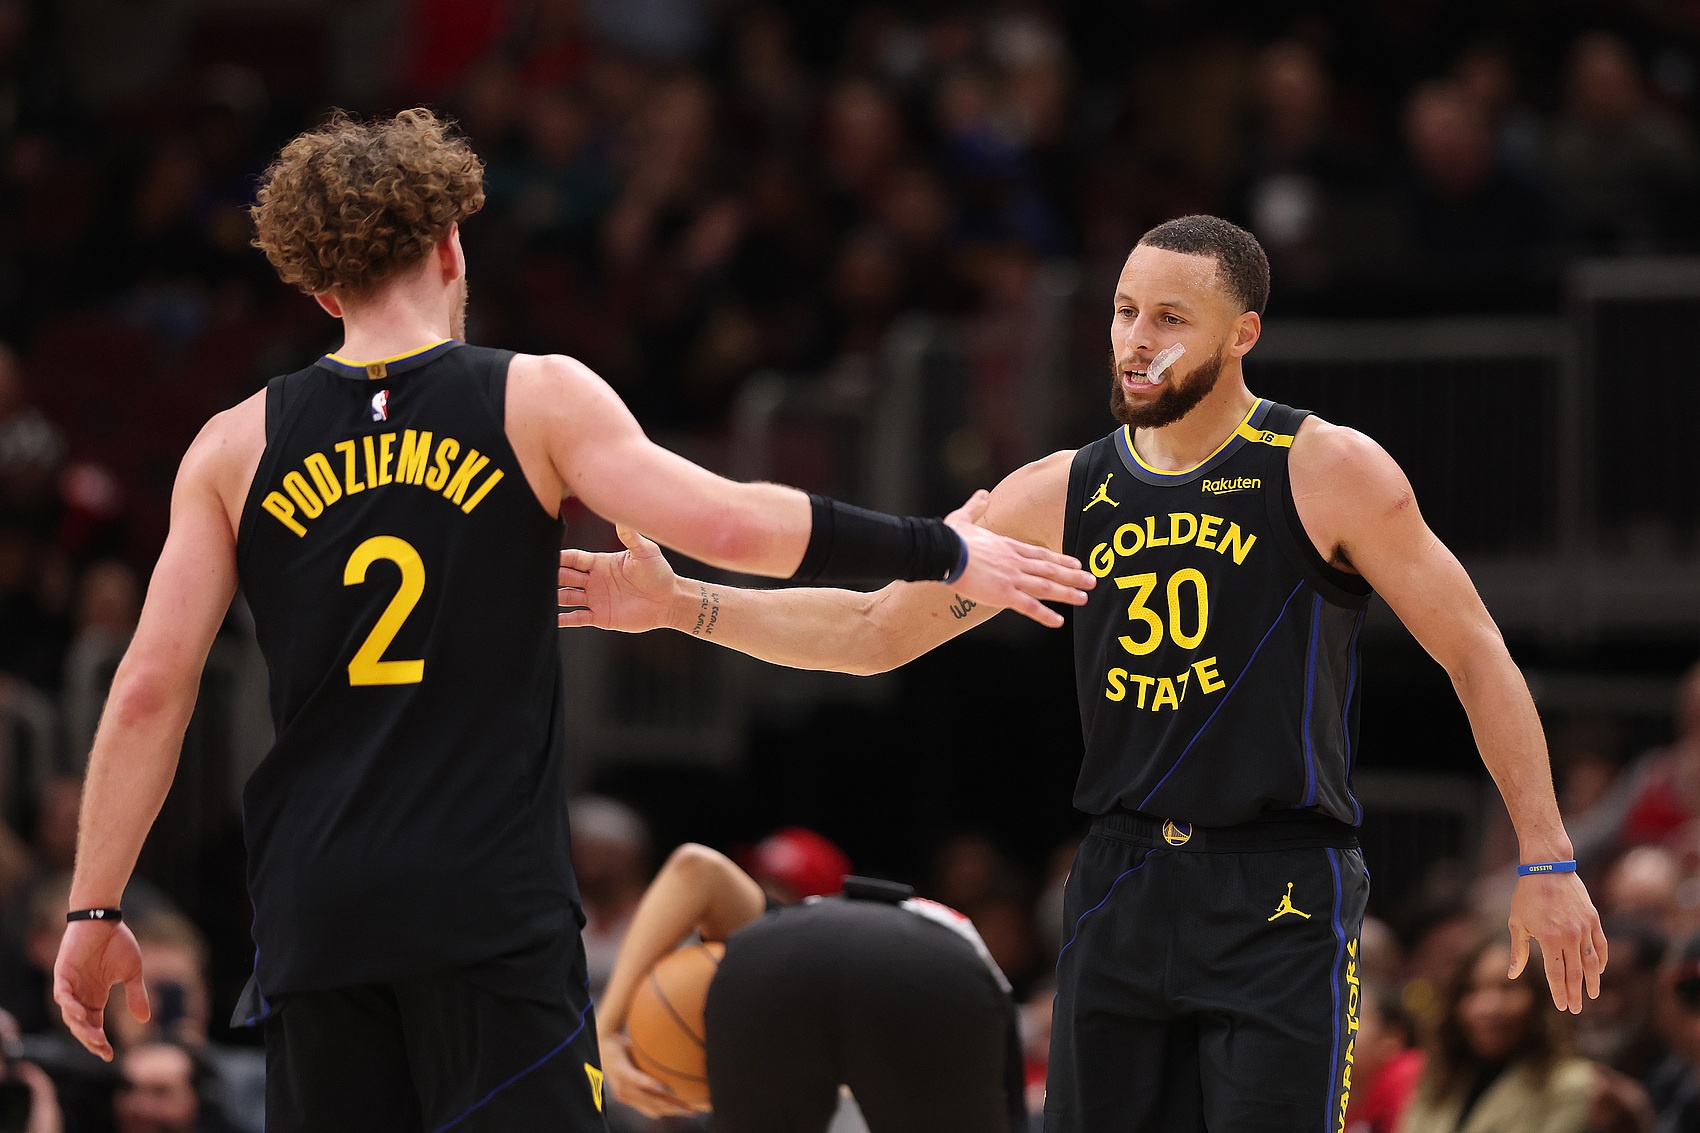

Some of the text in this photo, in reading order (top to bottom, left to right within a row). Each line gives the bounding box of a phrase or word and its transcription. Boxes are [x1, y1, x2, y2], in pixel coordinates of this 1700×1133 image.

[1259, 432, 1275, 443] 16
[261, 428, 505, 538] PODZIEMSKI
[1201, 476, 1262, 493] Rakuten
[1089, 512, 1257, 578] GOLDEN
[343, 535, 426, 687] 2
[1113, 567, 1209, 656] 30
[1105, 656, 1226, 712] STATE
[1529, 864, 1553, 872] BLESSED
